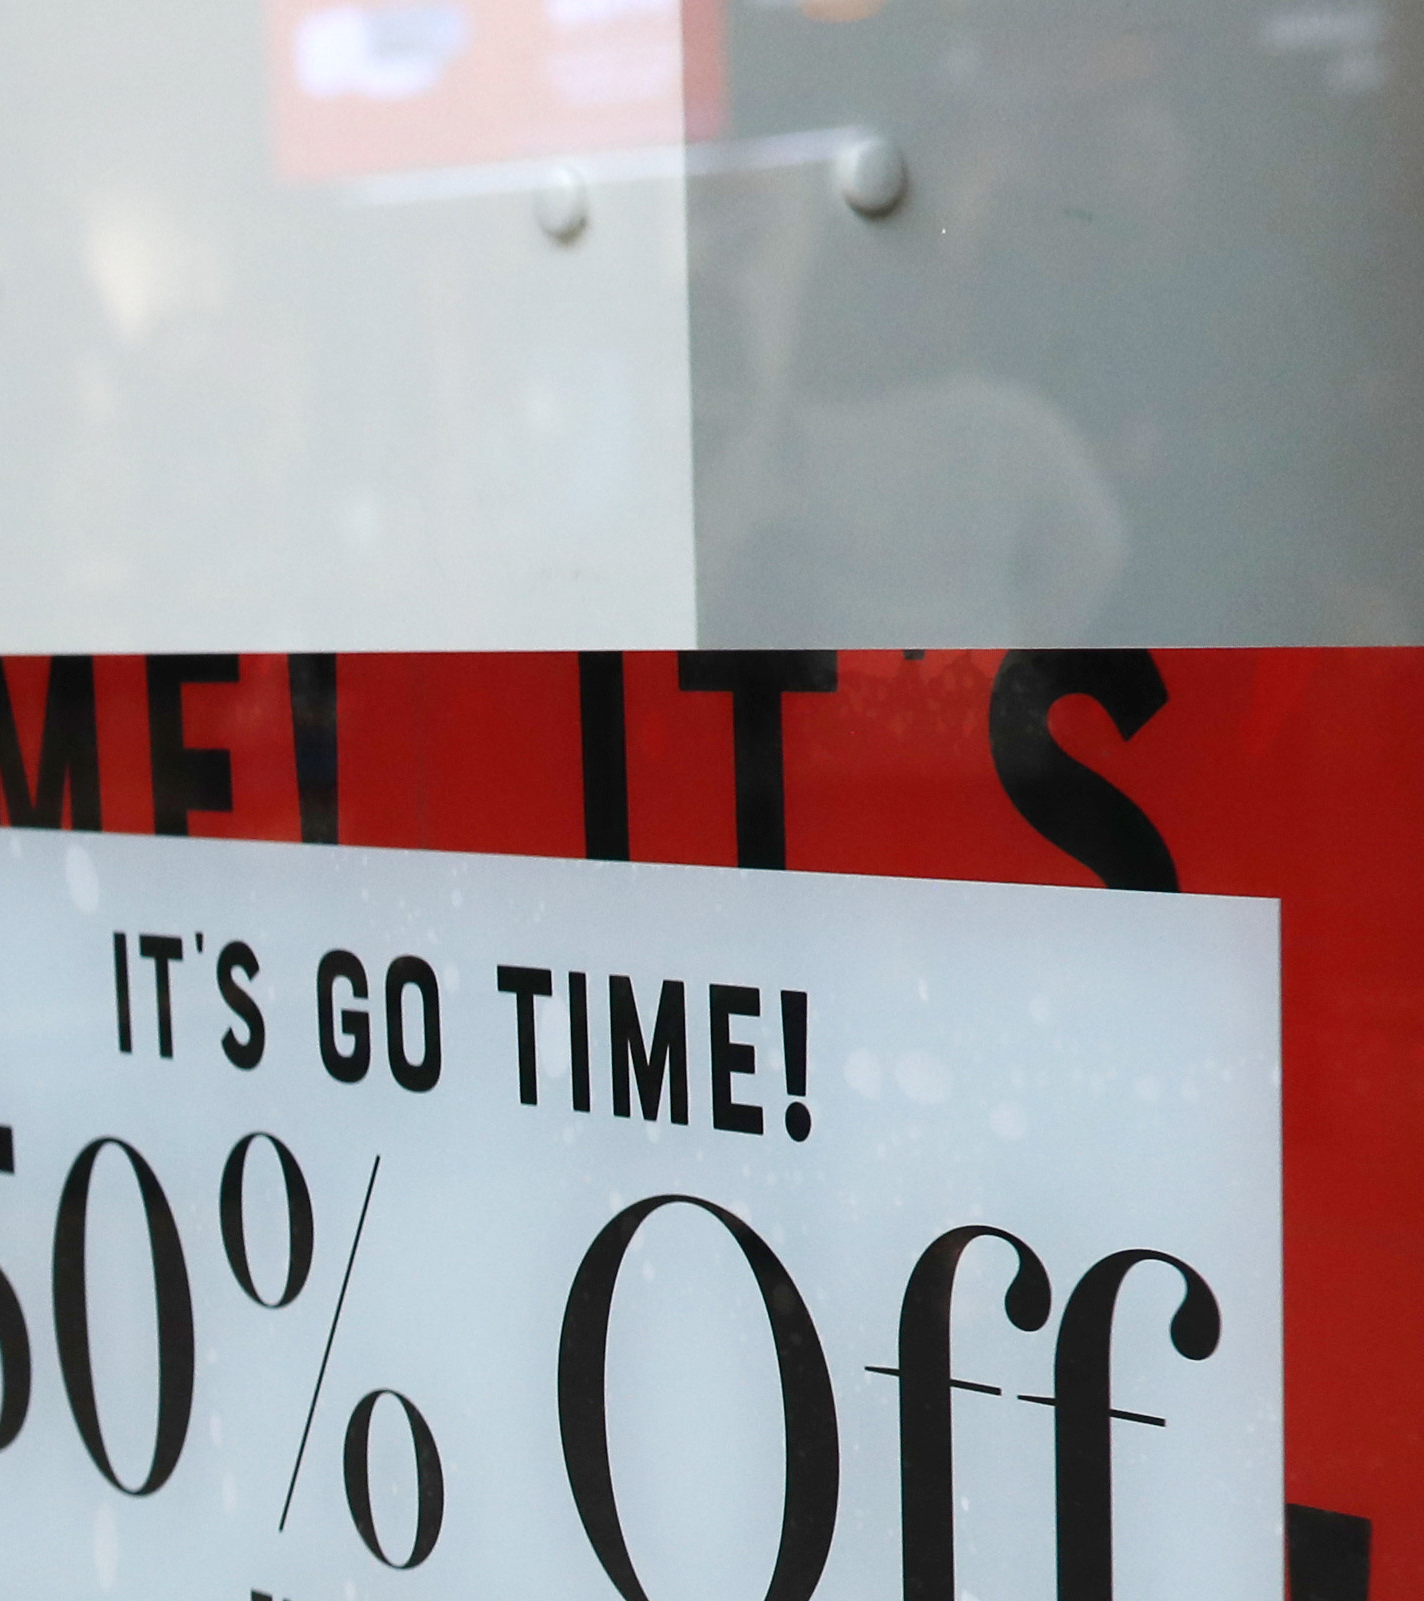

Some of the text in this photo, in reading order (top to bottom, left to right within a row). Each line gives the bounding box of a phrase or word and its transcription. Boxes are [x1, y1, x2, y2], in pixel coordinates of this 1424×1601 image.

[113, 932, 812, 1142] IT'S GO TIME!
